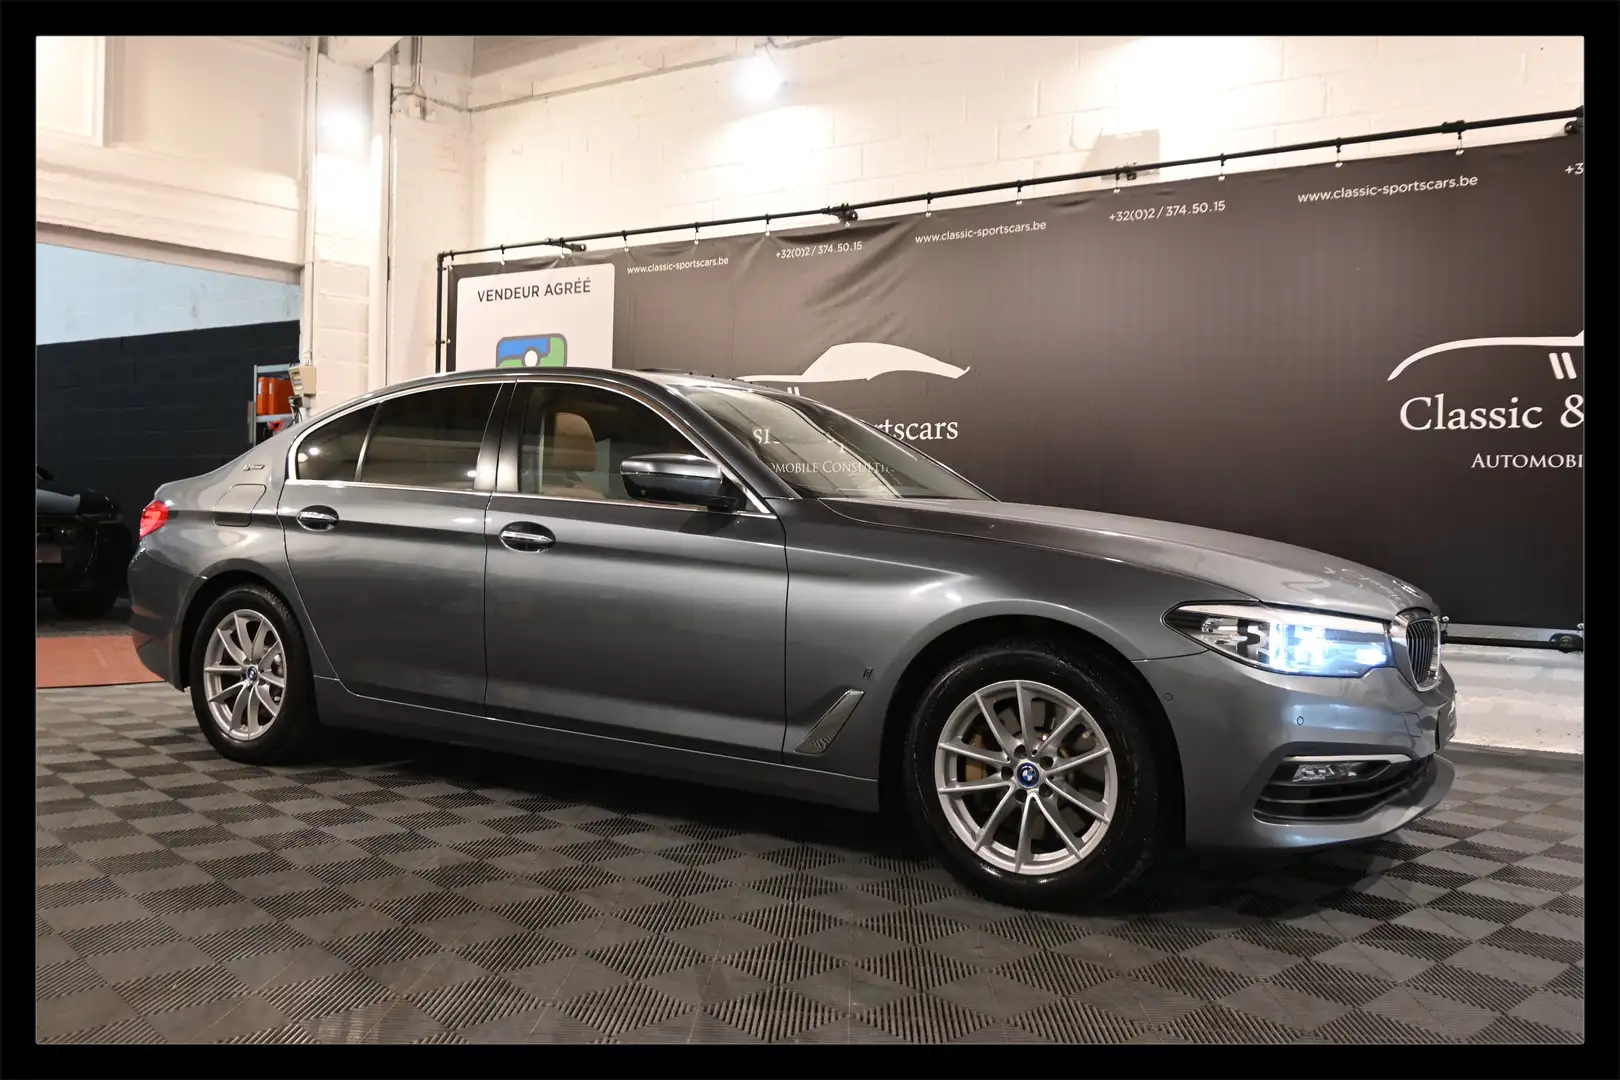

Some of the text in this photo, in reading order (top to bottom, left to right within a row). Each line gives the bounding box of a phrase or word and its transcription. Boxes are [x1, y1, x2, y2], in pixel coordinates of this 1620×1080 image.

[1298, 175, 1478, 203] www.classic-sportscars.be
[915, 221, 1047, 243] www.classic-sportscars.be
[626, 257, 729, 274] www.classic-sportscars.be
[477, 277, 592, 302] VENDEUR AGRÉÉ
[1400, 393, 1584, 430] Classic &
[771, 462, 818, 473] MOBILE
